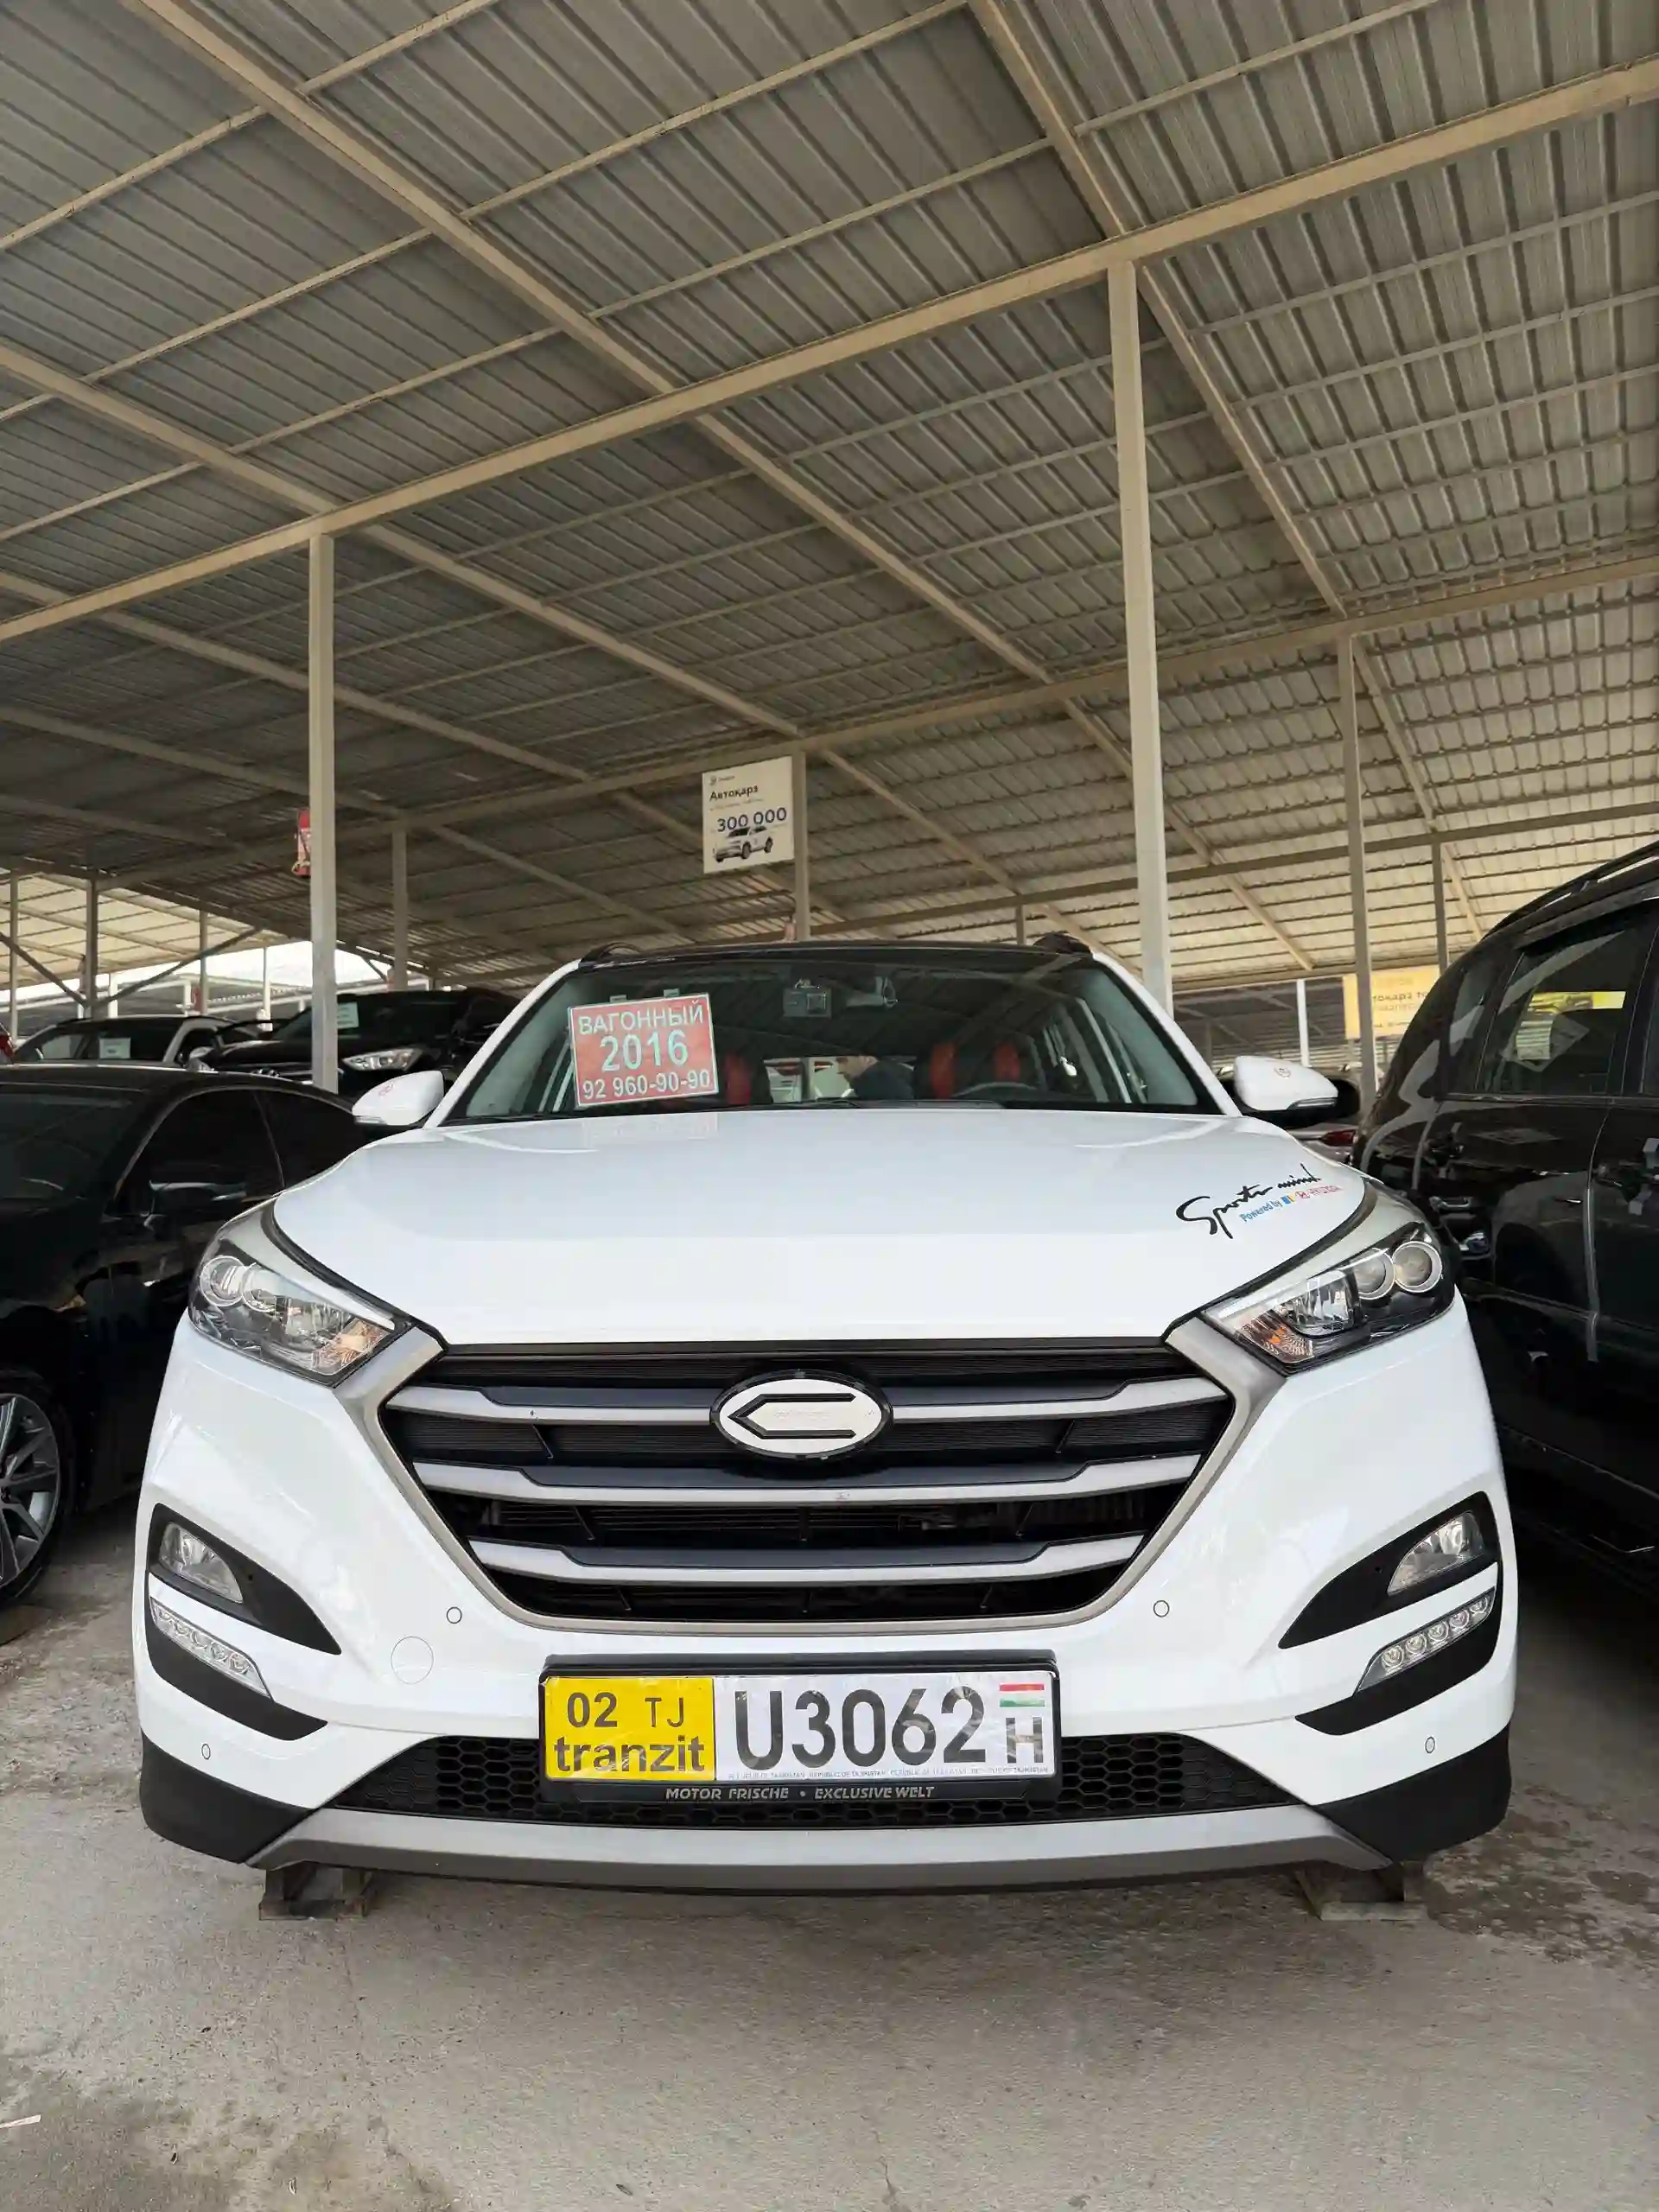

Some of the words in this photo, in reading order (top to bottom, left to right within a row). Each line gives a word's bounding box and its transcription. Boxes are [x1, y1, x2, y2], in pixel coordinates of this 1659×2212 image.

[717, 814, 748, 832] 300
[753, 807, 787, 825] 000
[578, 999, 703, 1035] ВАГОННЫЙ
[600, 1029, 689, 1071] 2016
[582, 1078, 607, 1100] 92
[613, 1069, 710, 1097] 960-90-90
[1239, 1202, 1274, 1223] Powered
[567, 1692, 618, 1727] 02
[734, 1686, 987, 1770] U3062
[1007, 1717, 1043, 1764] H
[554, 1734, 705, 1772] tranzit
[665, 1788, 722, 1800] MOTOR
[728, 1787, 789, 1800] FRISCHE
[814, 1786, 893, 1800] EXCLUSIVE
[895, 1786, 935, 1798] WELT
